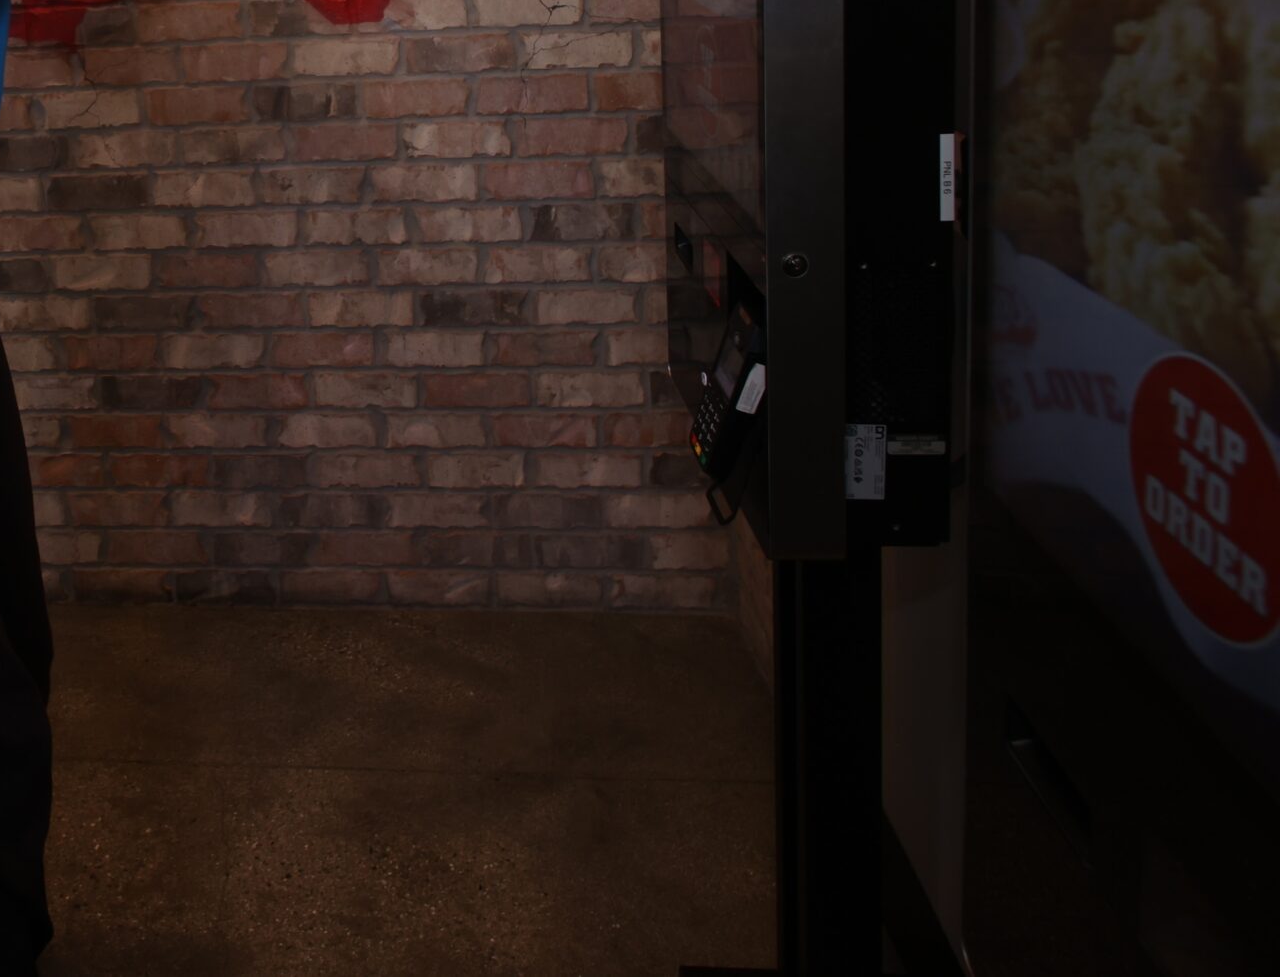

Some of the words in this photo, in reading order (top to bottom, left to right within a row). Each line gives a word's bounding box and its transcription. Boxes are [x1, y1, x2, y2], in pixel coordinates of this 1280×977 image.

[1168, 387, 1247, 478] TAP
[1178, 446, 1233, 527] TO
[1143, 473, 1271, 620] ORDER
